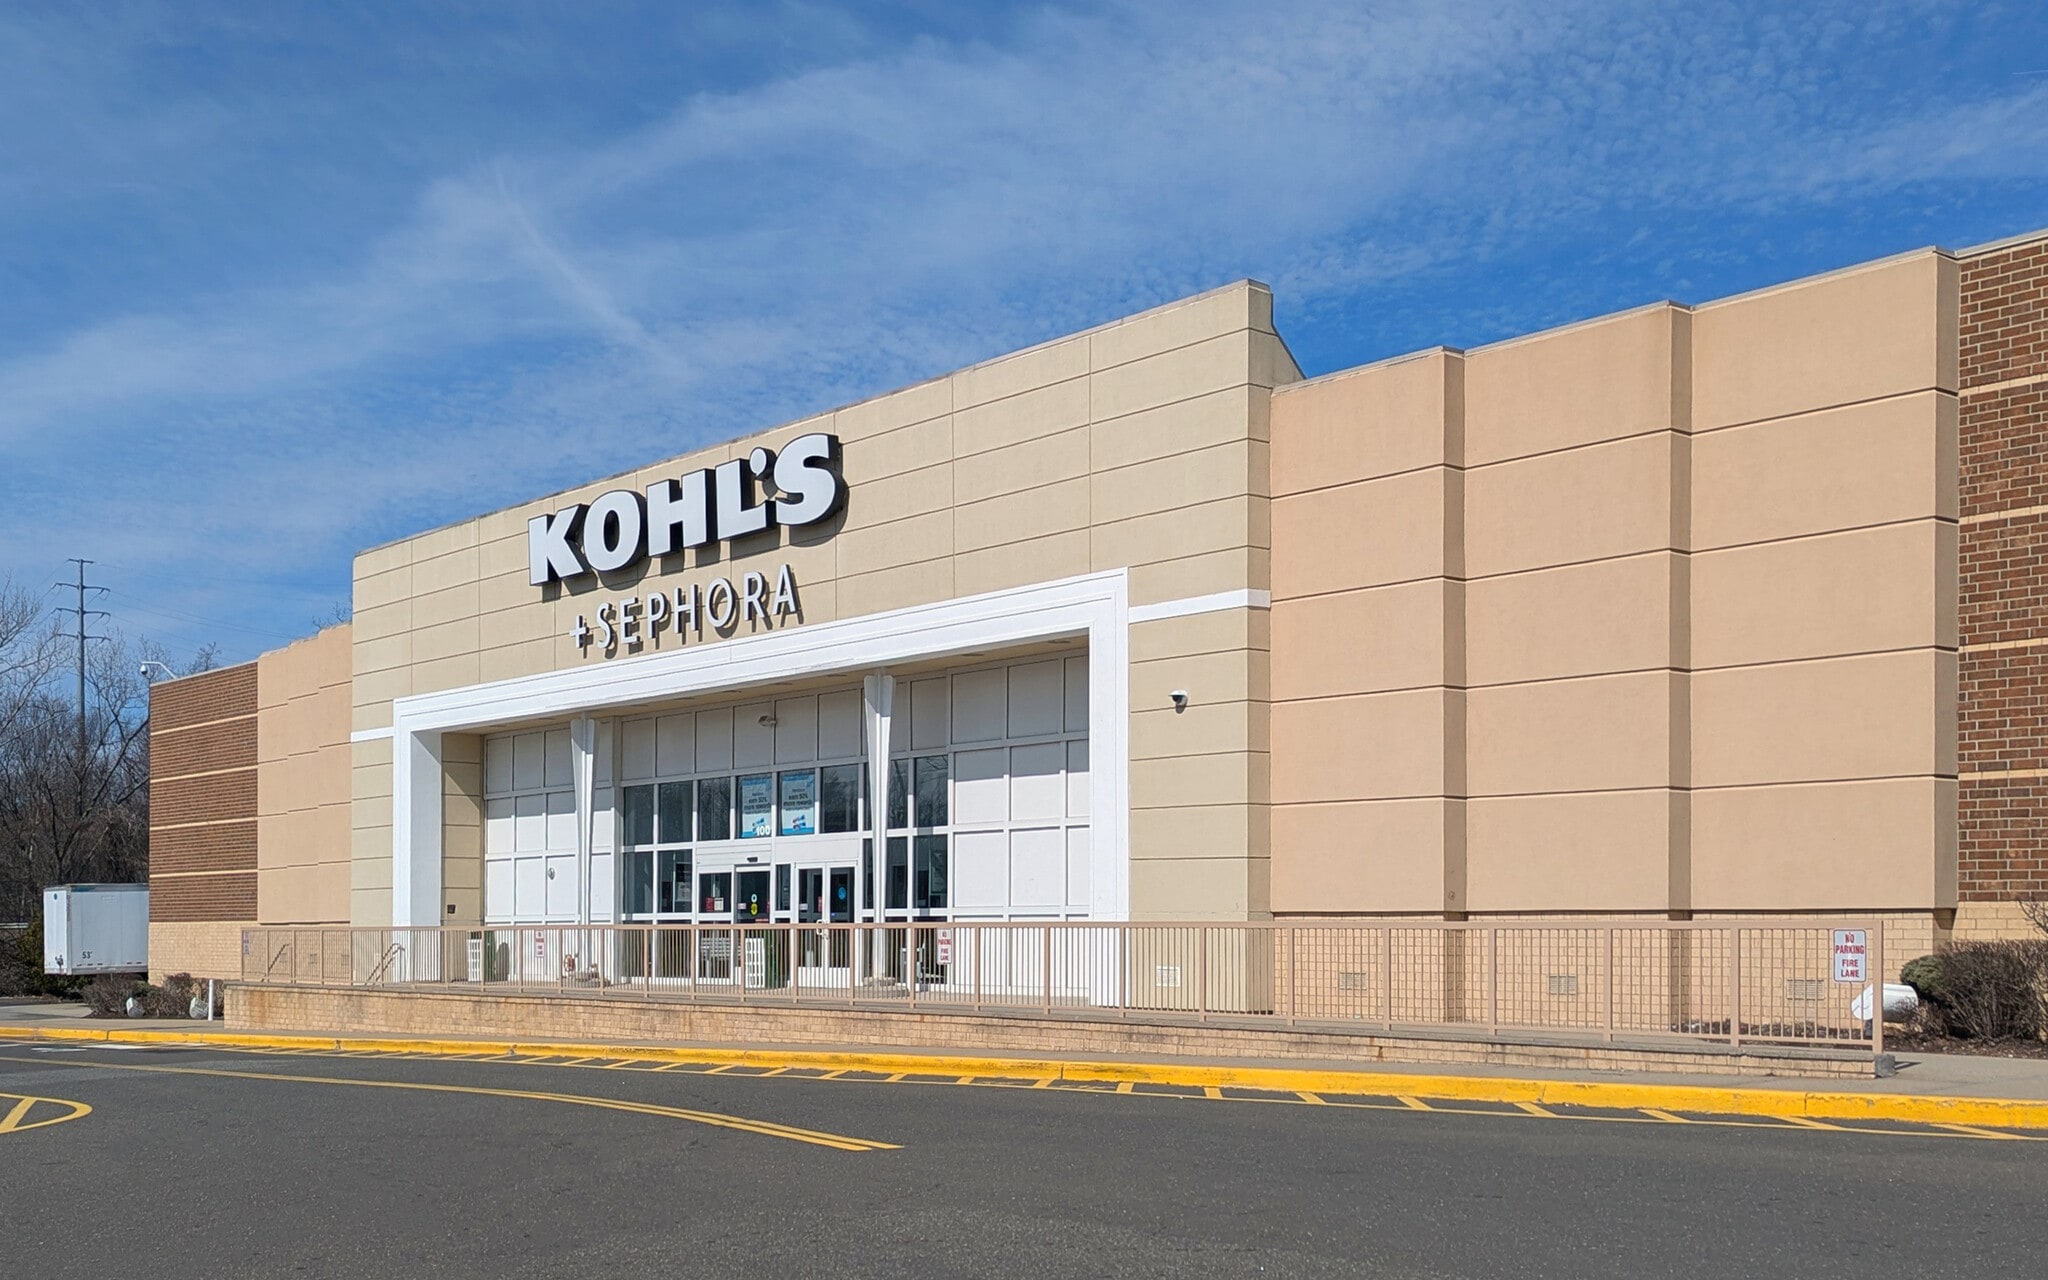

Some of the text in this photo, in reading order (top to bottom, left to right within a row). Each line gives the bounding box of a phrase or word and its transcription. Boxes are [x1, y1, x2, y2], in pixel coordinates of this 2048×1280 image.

[528, 432, 840, 586] KOHL'S
[755, 825, 771, 836] 100
[1845, 934, 1854, 943] NO
[1835, 945, 1864, 954] PARKING
[1842, 959, 1859, 967] FIRE
[1841, 969, 1859, 978] LANE
